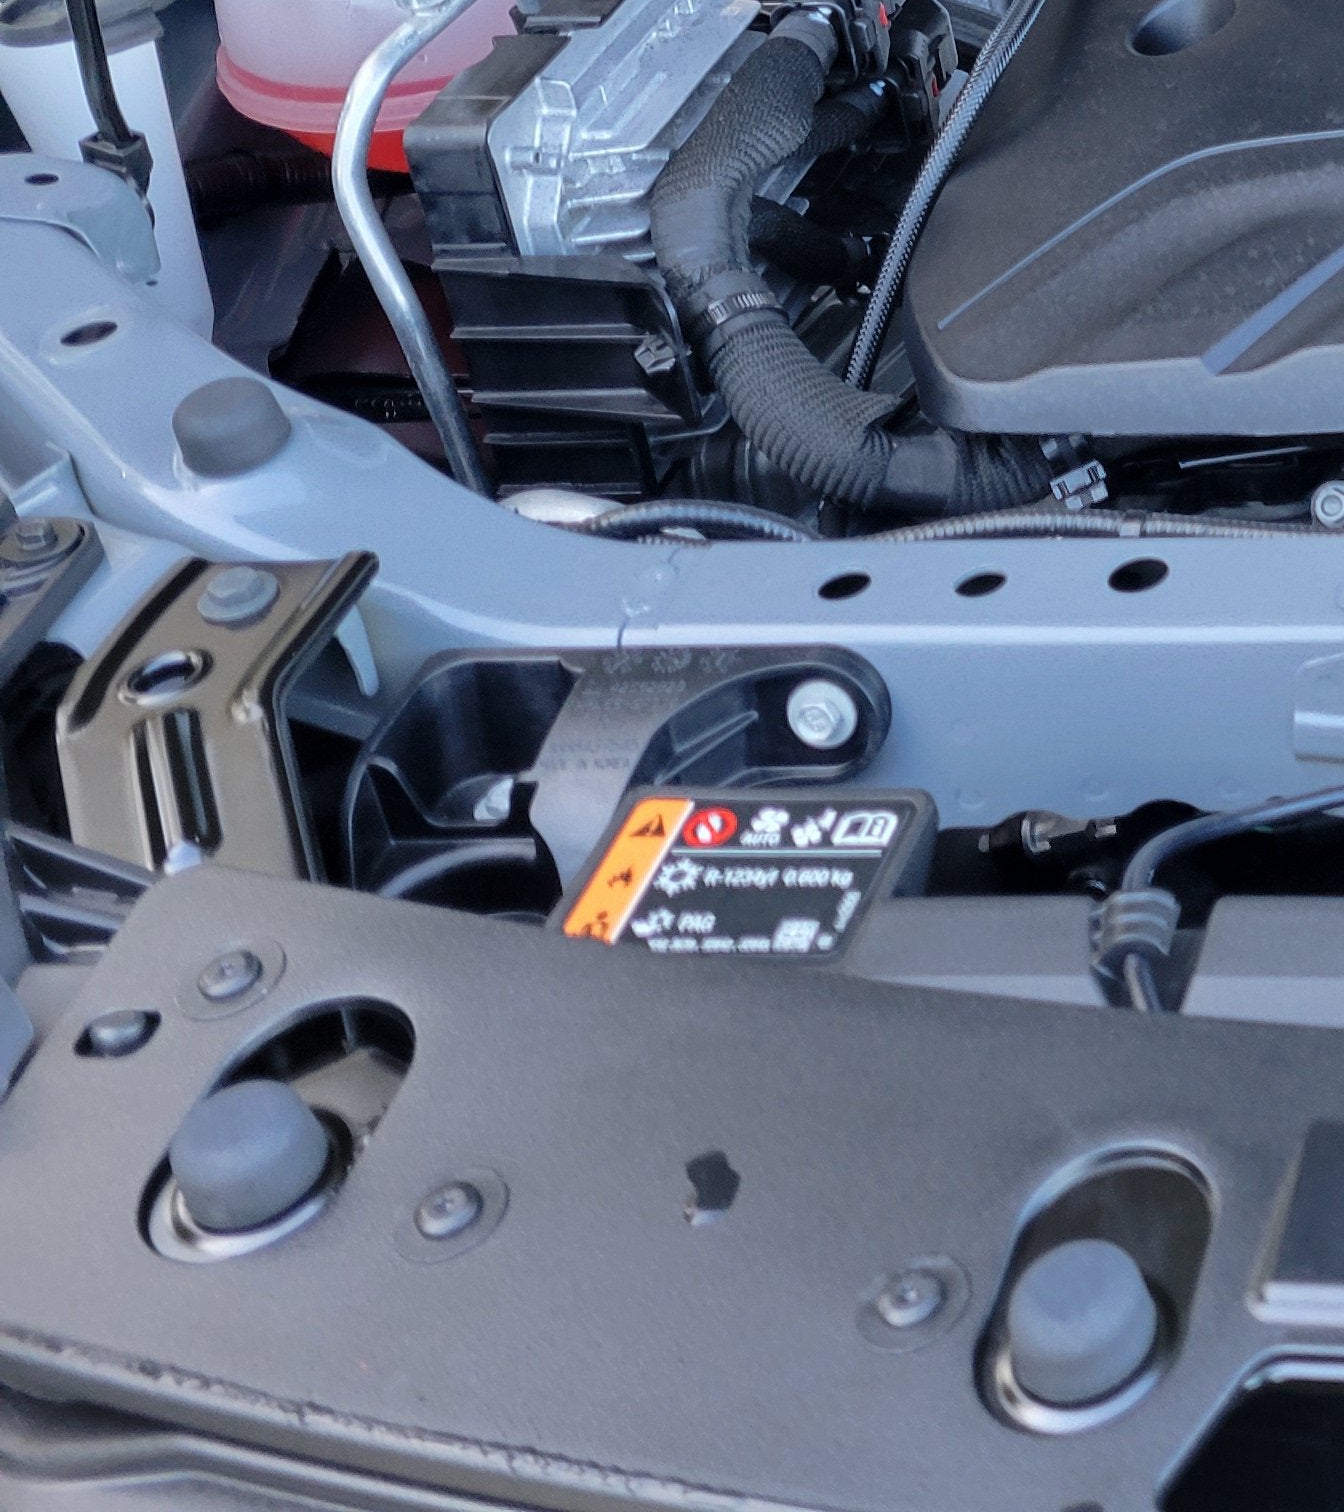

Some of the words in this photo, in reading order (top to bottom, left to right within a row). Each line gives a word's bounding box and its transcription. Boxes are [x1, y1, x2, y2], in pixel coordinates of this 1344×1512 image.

[739, 832, 781, 846] AUTO
[703, 865, 779, 890] R-1234yf
[830, 867, 854, 890] kg
[677, 910, 716, 934] PAG
